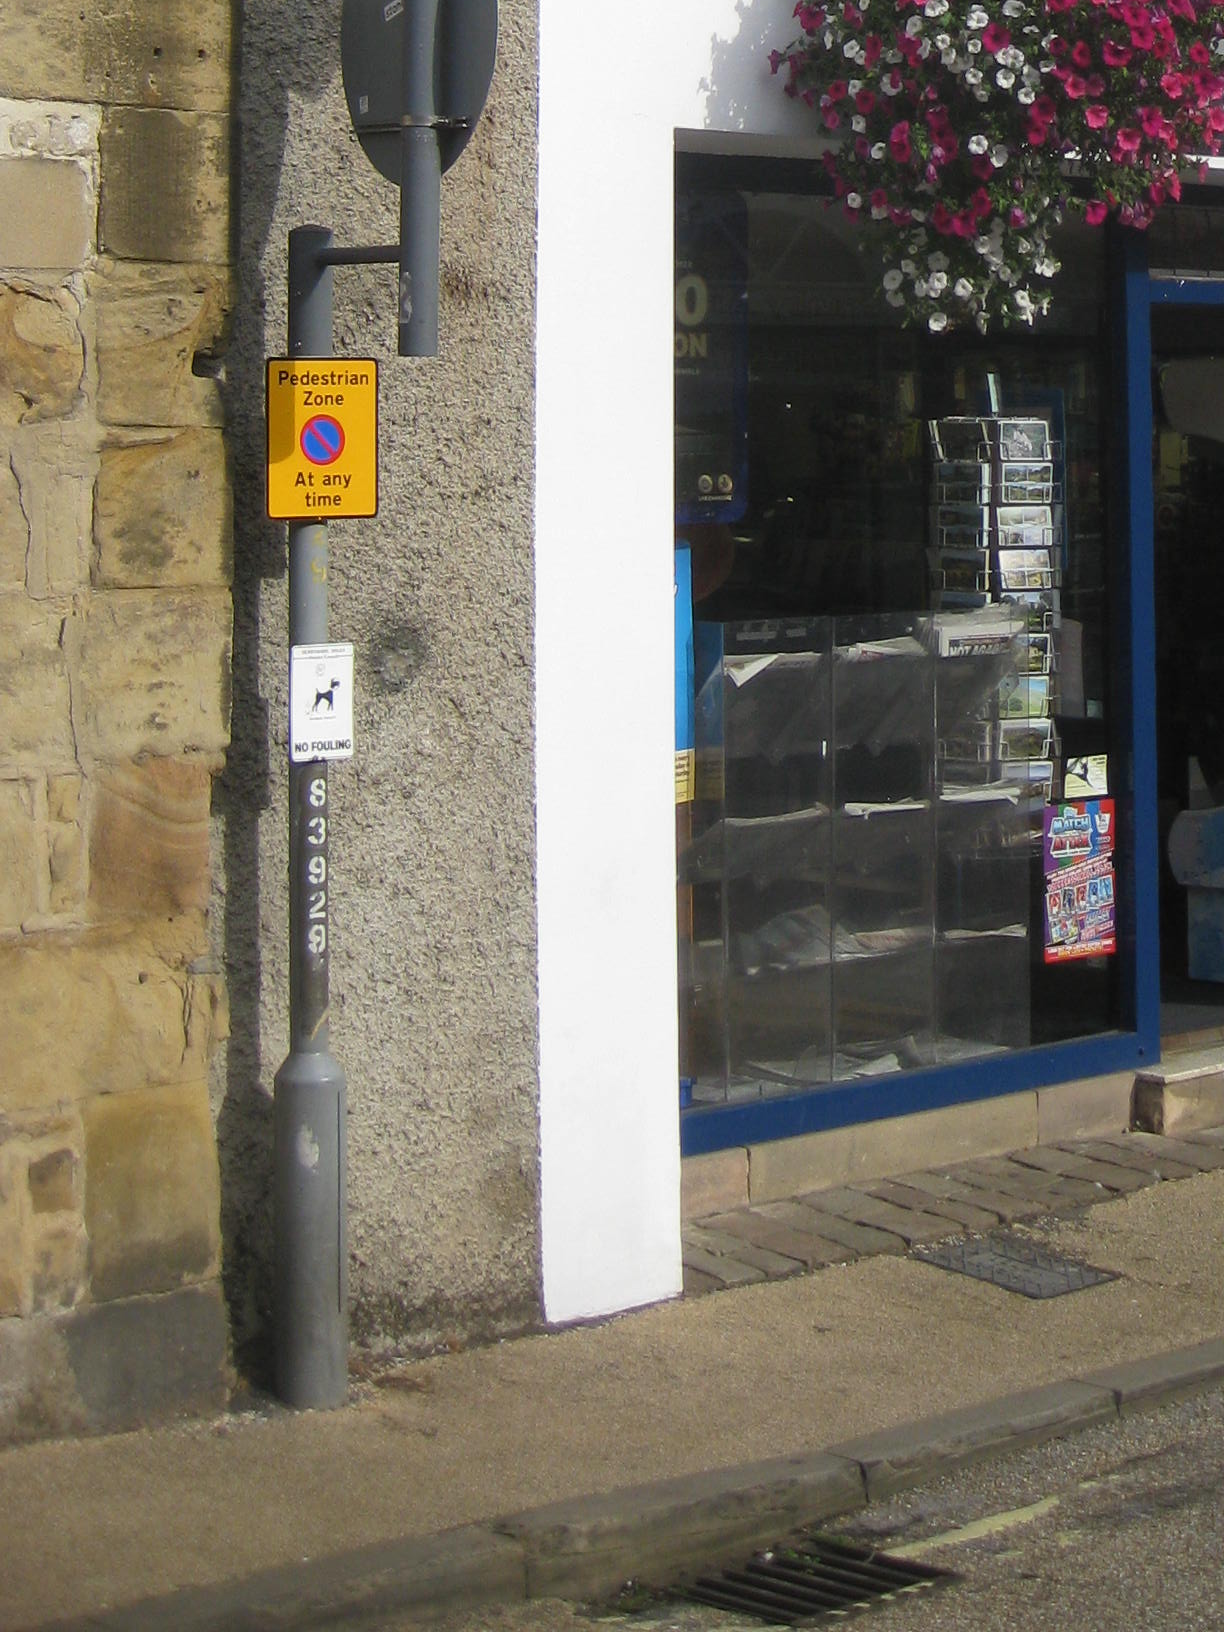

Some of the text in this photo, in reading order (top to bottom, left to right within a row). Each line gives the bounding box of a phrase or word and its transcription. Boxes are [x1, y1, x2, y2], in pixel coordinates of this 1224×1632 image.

[278, 370, 369, 386] Pedestrian
[303, 390, 345, 406] Zone
[294, 471, 352, 489] At any
[305, 492, 342, 507] time
[294, 738, 352, 753] NO FOULING
[1052, 817, 1090, 833] MATCH
